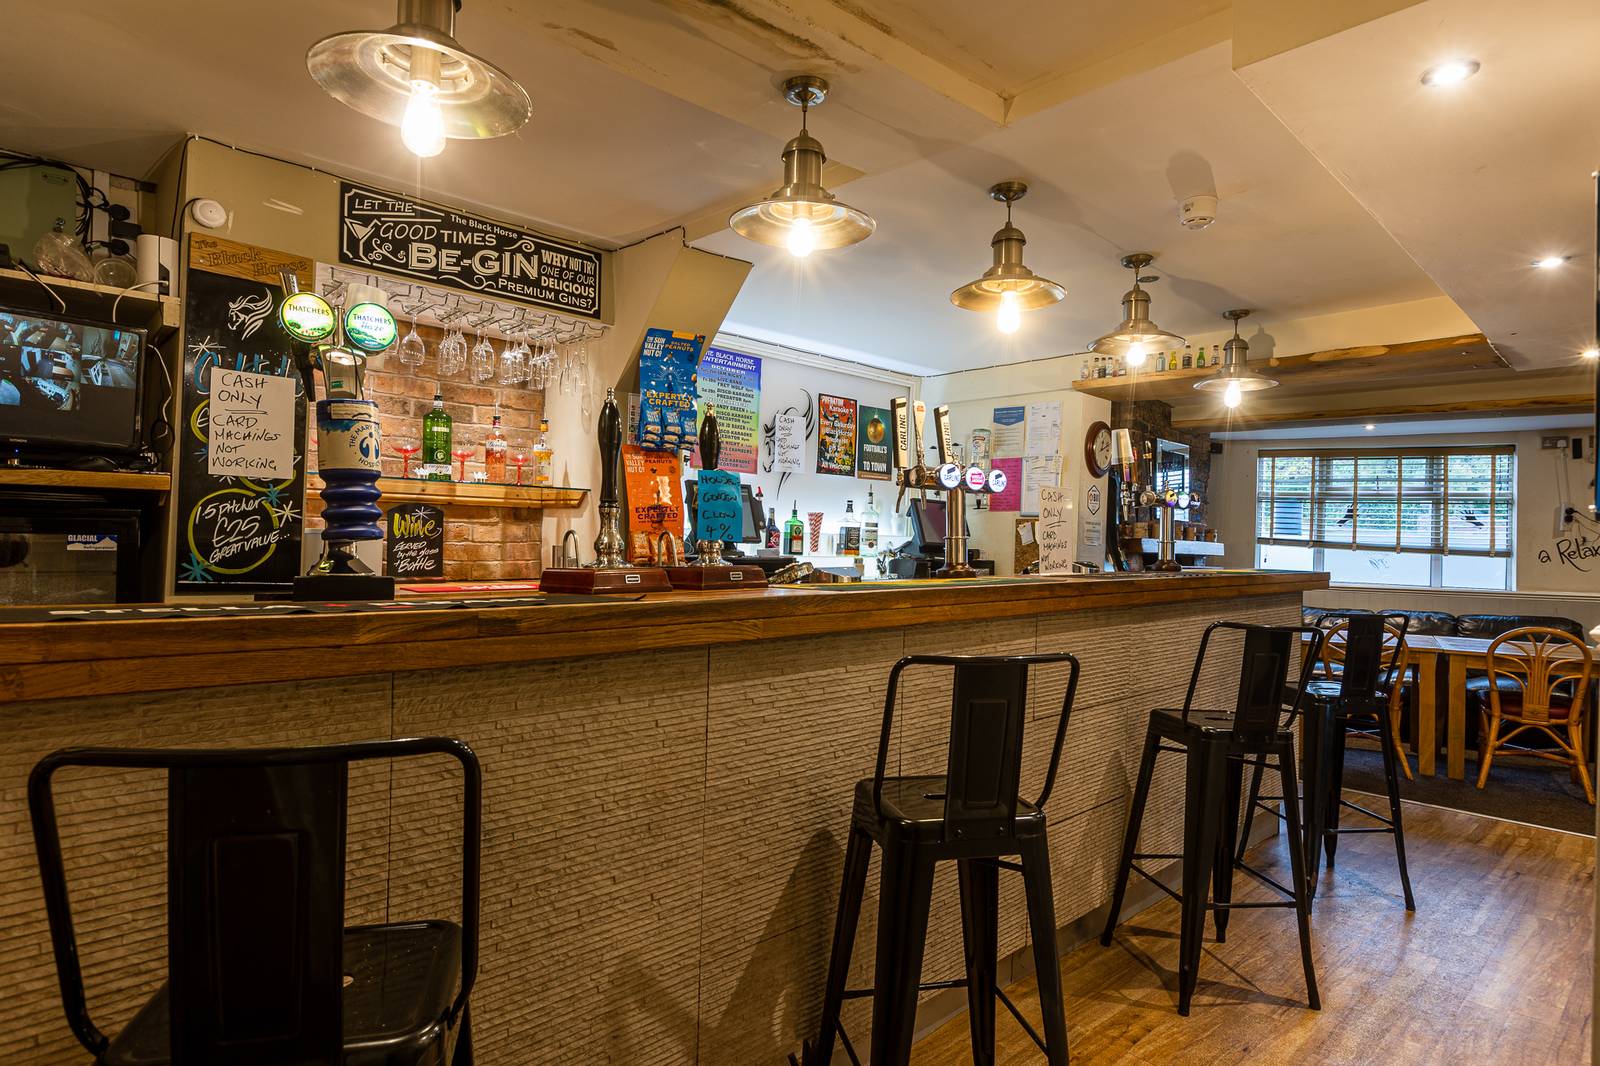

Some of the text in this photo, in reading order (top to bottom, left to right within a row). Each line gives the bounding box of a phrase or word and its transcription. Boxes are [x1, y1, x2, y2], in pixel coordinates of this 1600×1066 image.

[355, 199, 413, 212] LET THE
[380, 222, 437, 240] GOOD
[450, 214, 518, 239] The Black Horse
[440, 230, 497, 246] TIMES
[408, 242, 538, 279] BE-GIN
[541, 250, 595, 275] WHY NOT TRY
[541, 265, 595, 286] ONE OF OUR
[498, 278, 592, 308] PREMIUM GINS?
[541, 276, 595, 297] DELICIOUS
[288, 304, 330, 316] THATCHERS
[353, 313, 392, 325] THATCHERS
[665, 344, 694, 352] PEANUTS
[716, 352, 734, 361] BLACK
[736, 357, 755, 365] HORSE
[222, 372, 268, 389] CASH
[218, 389, 262, 409] ONLY
[646, 391, 692, 401] EXPERTLY
[649, 398, 690, 408] CRAFTED
[213, 415, 257, 429] CARD
[899, 414, 907, 451] CARLING
[216, 442, 245, 455] NOT
[349, 434, 358, 449] THE
[992, 479, 1005, 487] CARLIN
[1041, 489, 1064, 502] CASH
[635, 505, 680, 514] EXPERTLY
[637, 512, 678, 520] CRAFTED
[1042, 507, 1064, 519] ONLY
[212, 516, 260, 547] £25
[393, 513, 438, 538] Wine
[209, 542, 244, 563] GREAT
[393, 541, 427, 552] SERVED
[398, 556, 437, 573] Bottle
